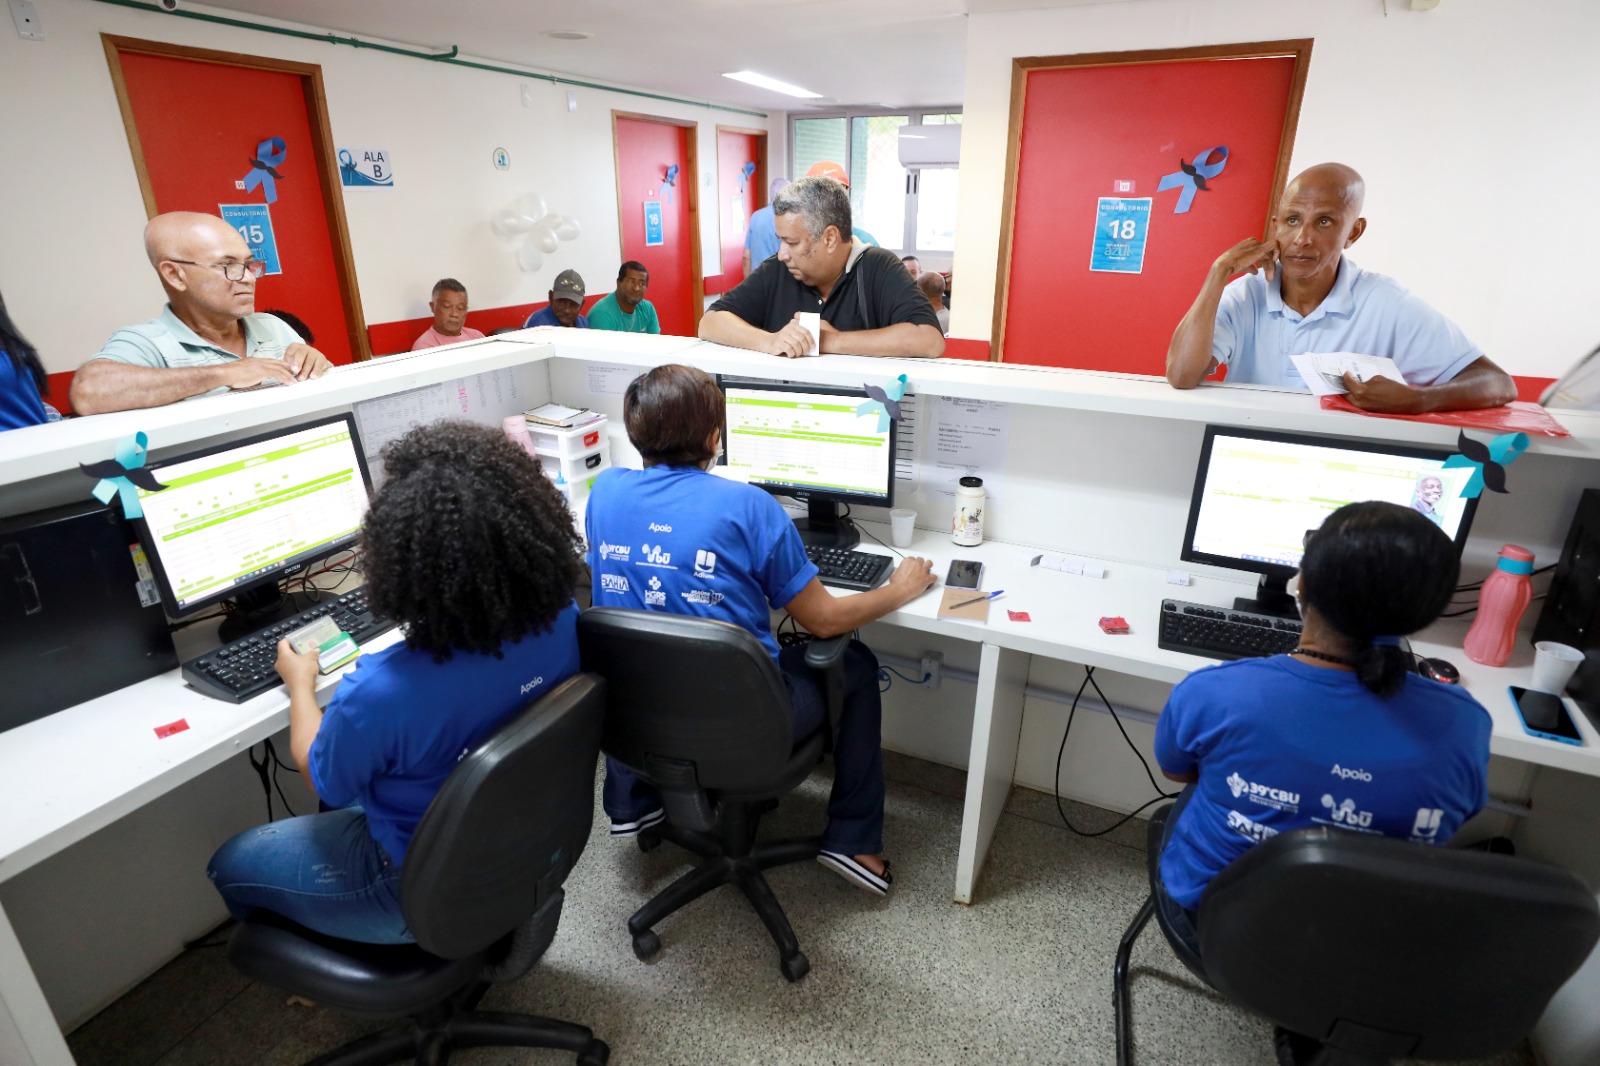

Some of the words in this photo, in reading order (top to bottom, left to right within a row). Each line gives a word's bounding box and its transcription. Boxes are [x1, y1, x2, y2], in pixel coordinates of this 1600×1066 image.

[363, 151, 385, 163] ALA
[373, 164, 383, 178] B
[239, 225, 264, 244] 15
[1109, 219, 1136, 240] 18
[649, 522, 672, 533] Apoio
[520, 676, 543, 695] Apoio
[1331, 763, 1373, 783] Apoio
